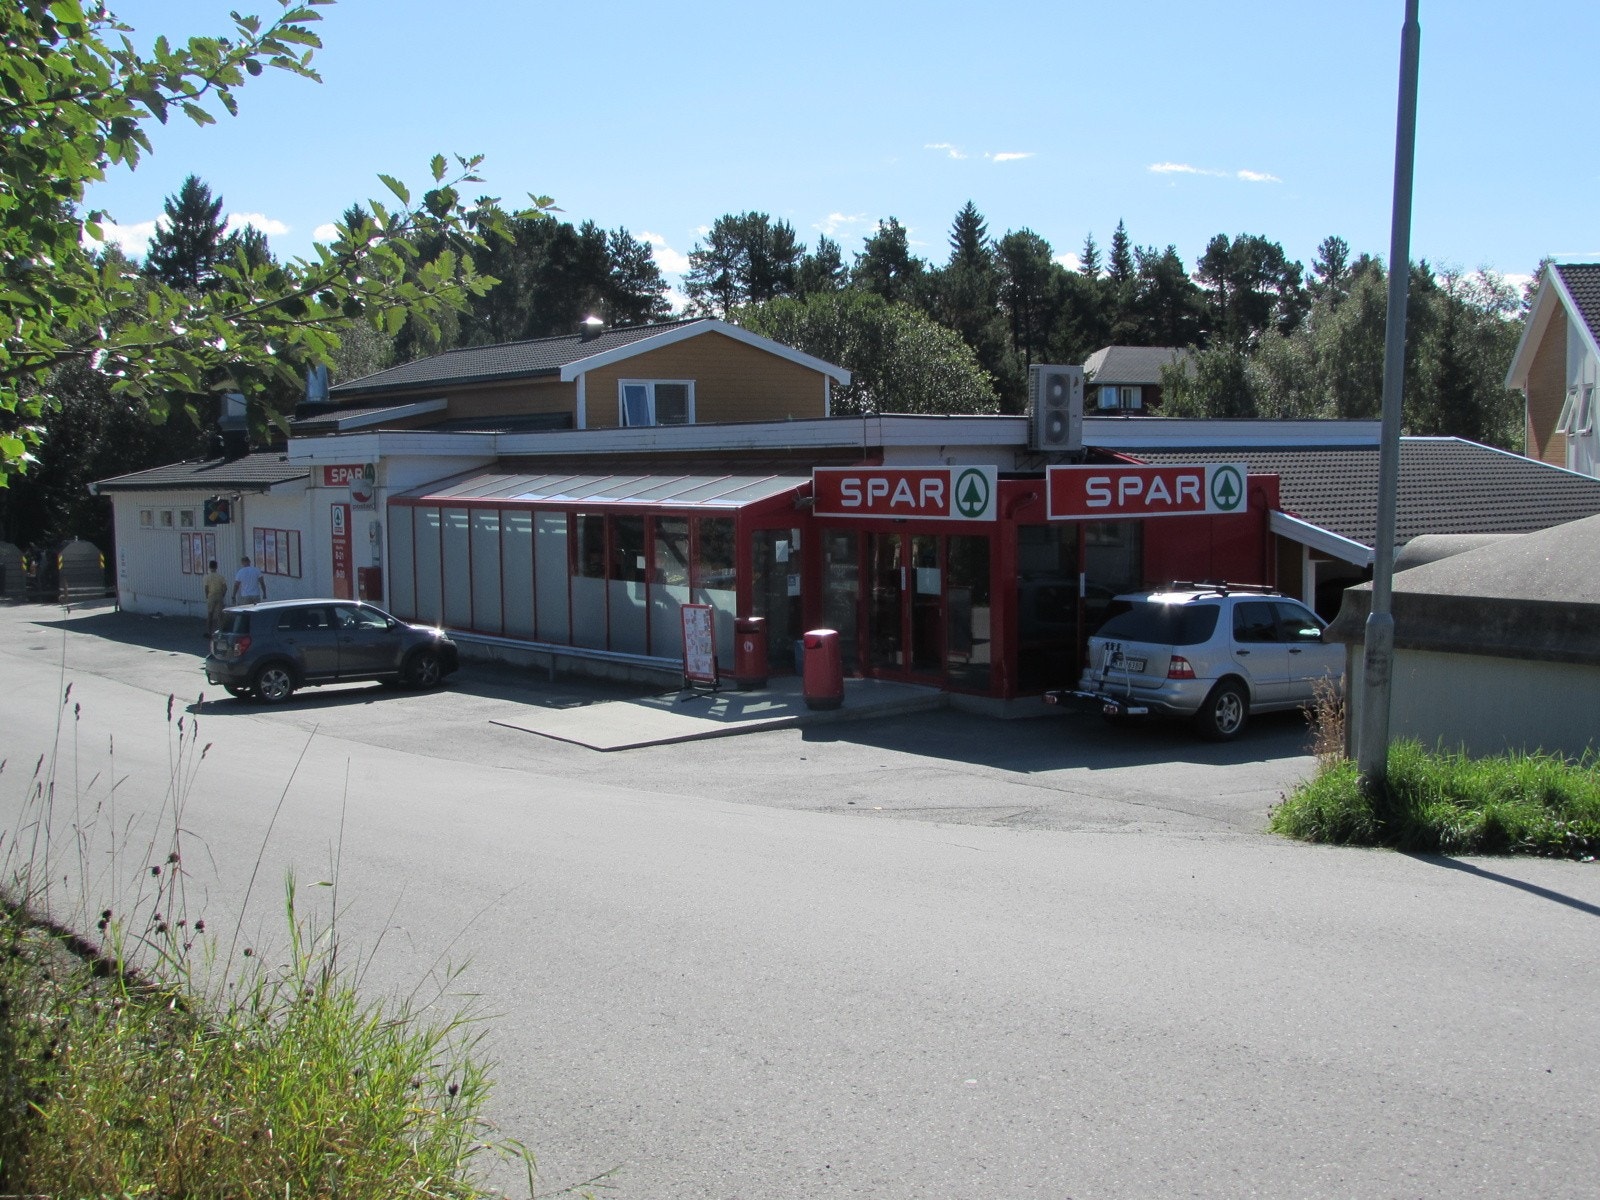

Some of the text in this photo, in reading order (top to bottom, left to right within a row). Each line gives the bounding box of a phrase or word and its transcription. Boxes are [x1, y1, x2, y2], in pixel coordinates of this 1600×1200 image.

[331, 467, 363, 483] SPAR
[840, 477, 944, 508] SPAR
[1085, 475, 1200, 507] SPAR
